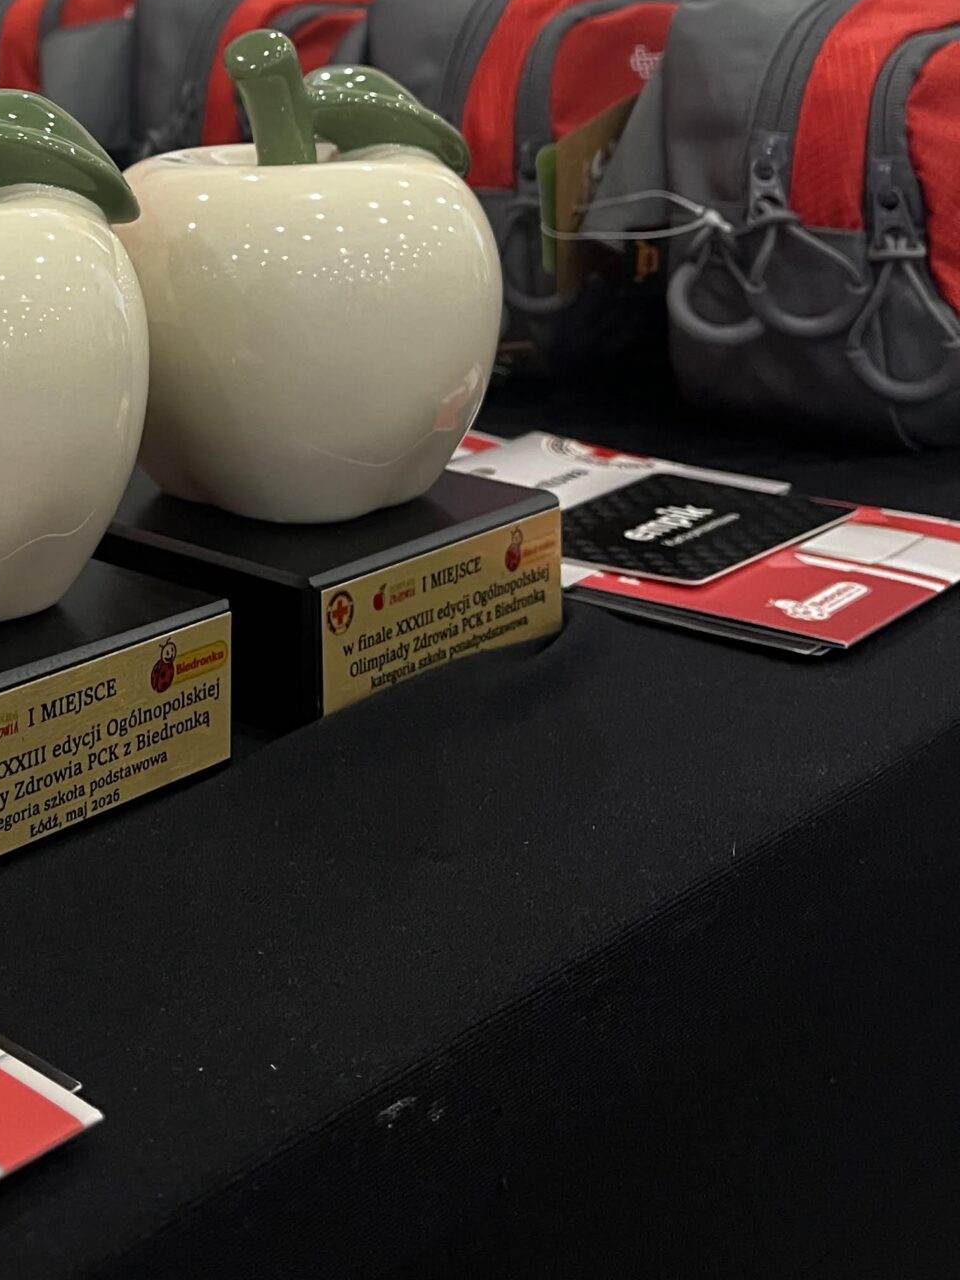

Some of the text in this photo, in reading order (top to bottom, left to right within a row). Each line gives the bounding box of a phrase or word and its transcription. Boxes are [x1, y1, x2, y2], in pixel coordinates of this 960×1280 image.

[343, 563, 550, 657] w finale XXXIII edycji Ogólnopolskiej
[421, 576, 426, 592] I
[431, 556, 482, 590] MIEJSCE
[350, 588, 545, 678] Olimpiady Zdrowia PCK z Biedronką
[27, 708, 35, 728] I
[40, 678, 118, 722] MIEJSCE
[176, 650, 224, 676] Biedronka
[370, 662, 416, 689] kategoria
[14, 761, 83, 801] Zdrowia
[87, 743, 119, 771] PCK
[123, 742, 132, 757] z
[136, 709, 210, 752] Biedronką
[52, 723, 101, 758] edycji
[106, 677, 221, 737] Ogólnopolskiej
[43, 784, 86, 811] szkoła
[90, 751, 168, 797] podstawowa
[66, 802, 88, 819] maj
[92, 788, 120, 812] 2026
